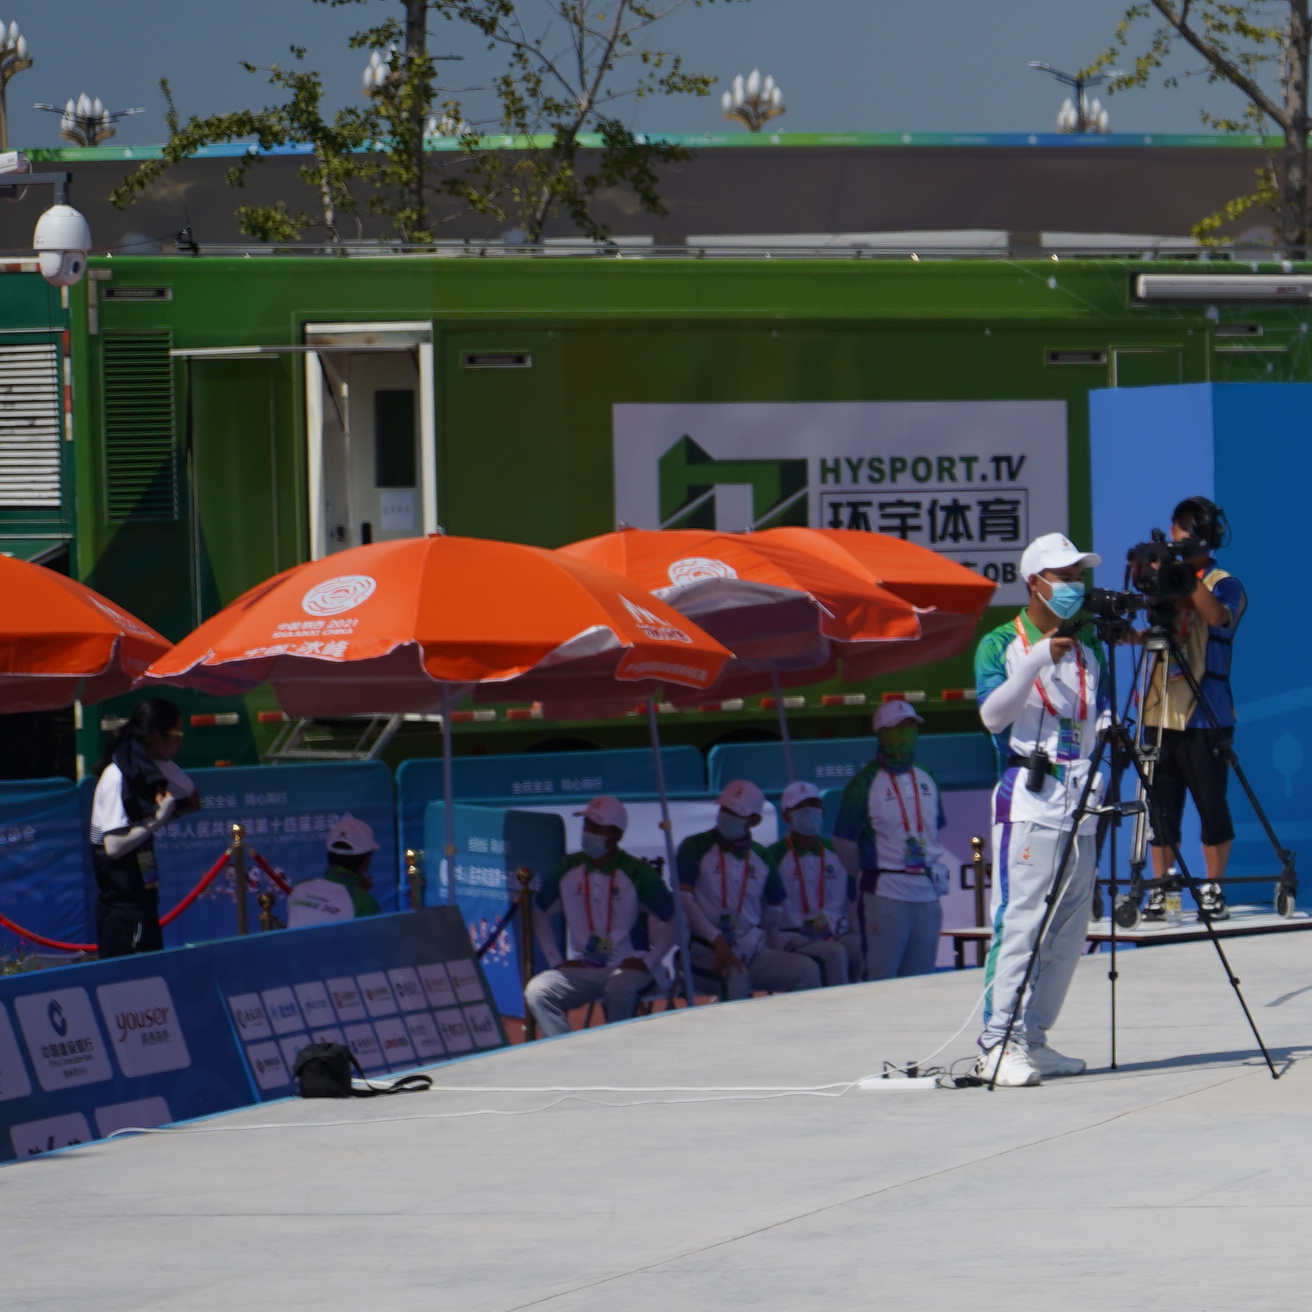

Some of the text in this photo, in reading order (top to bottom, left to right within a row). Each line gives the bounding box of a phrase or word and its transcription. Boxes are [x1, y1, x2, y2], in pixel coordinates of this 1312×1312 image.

[820, 455, 1026, 484] HYSPORT.TV
[828, 498, 1021, 542] 环宇体育
[115, 1007, 170, 1042] youser
